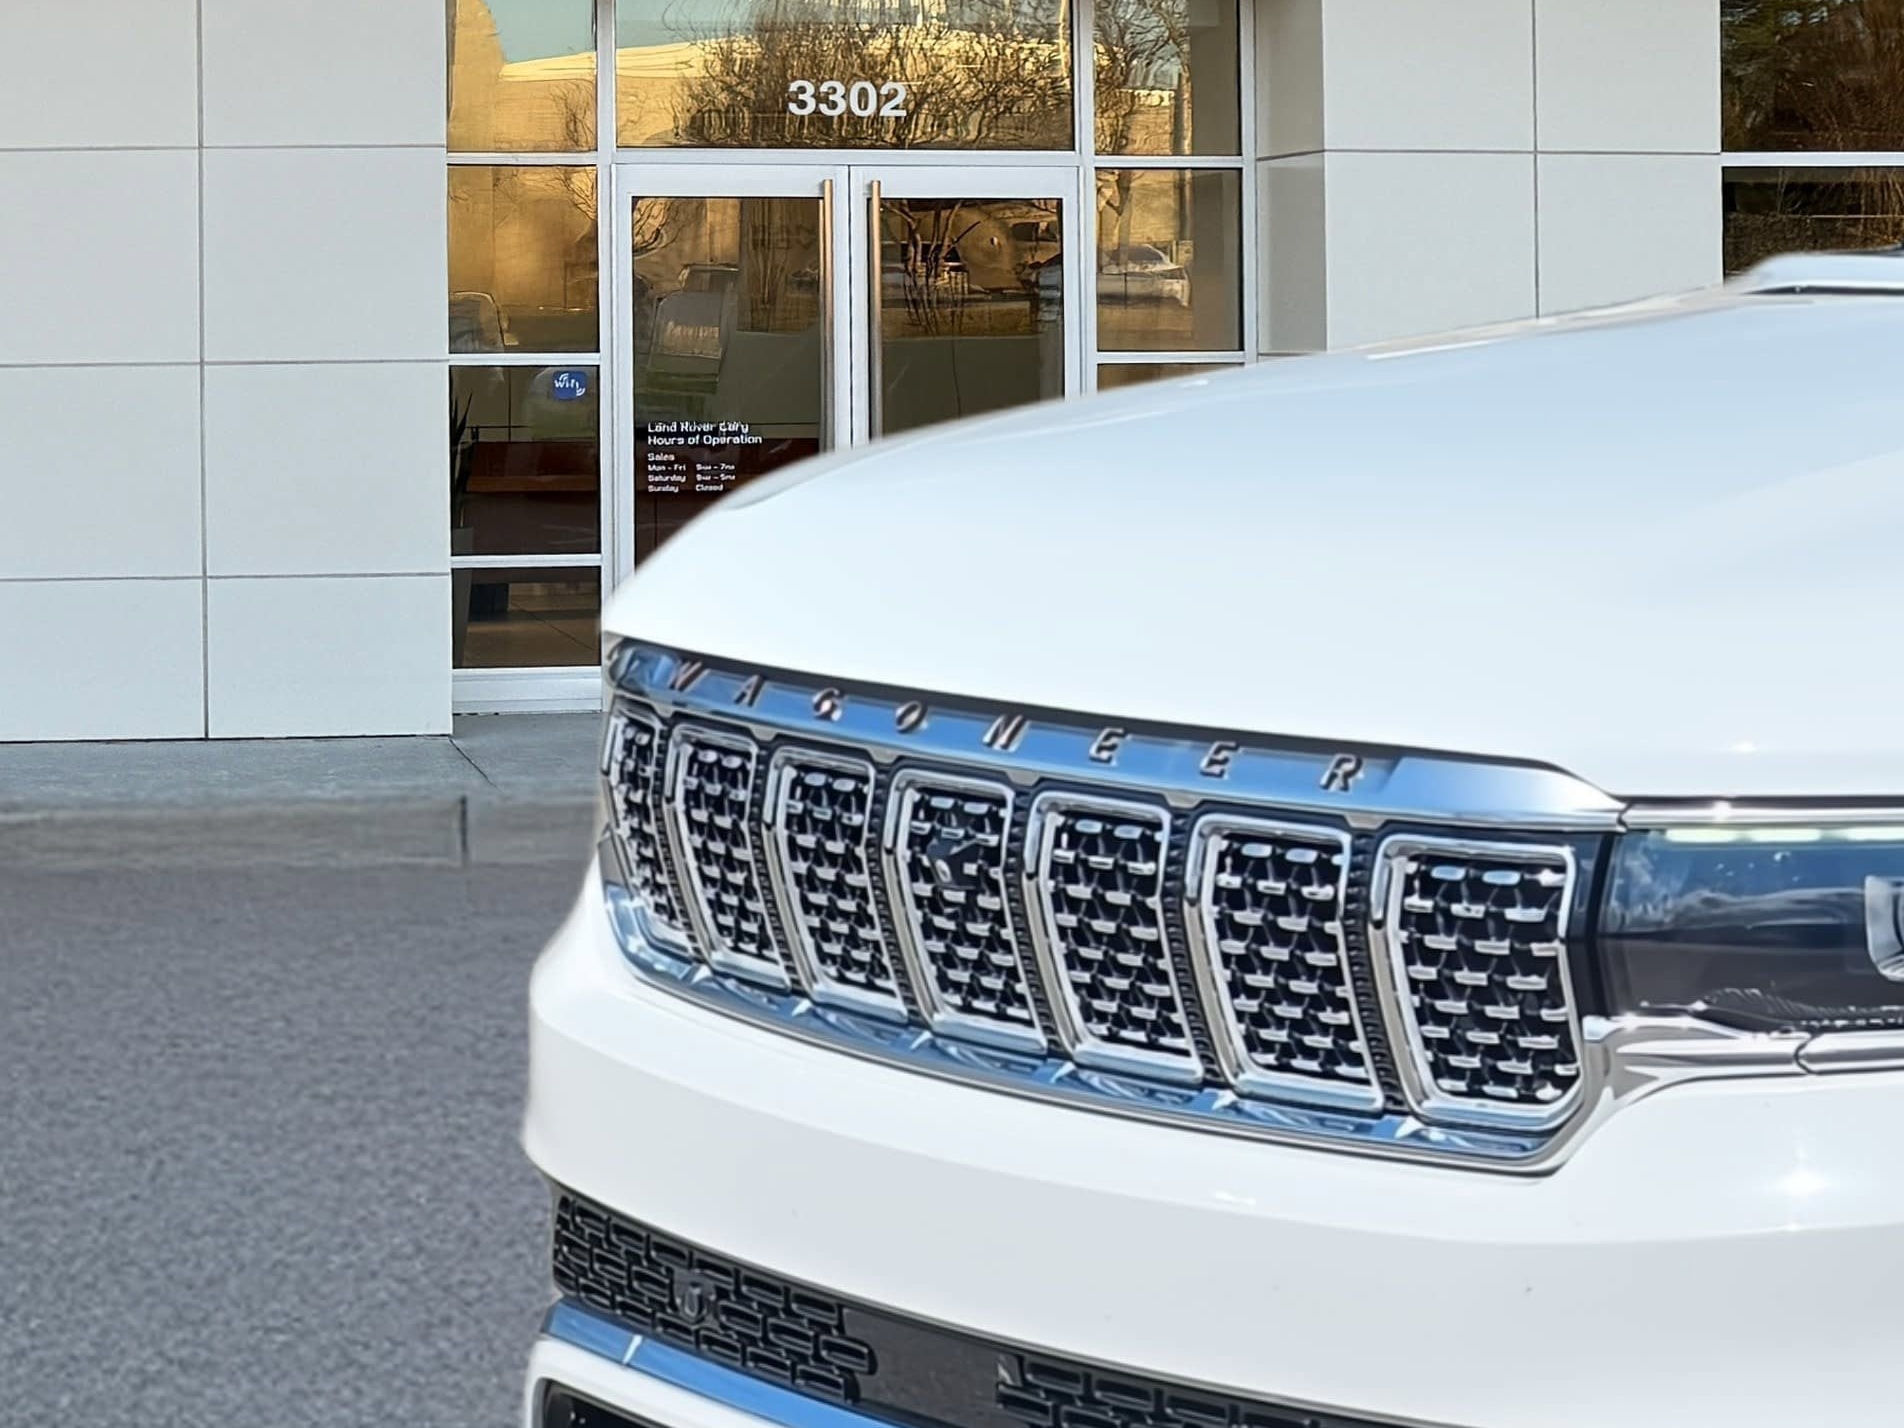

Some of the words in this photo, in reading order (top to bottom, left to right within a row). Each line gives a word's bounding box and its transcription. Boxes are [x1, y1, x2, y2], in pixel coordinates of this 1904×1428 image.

[786, 79, 909, 119] 3302
[647, 435, 685, 445] Hours
[687, 434, 699, 445] of
[703, 434, 762, 447] Operation
[667, 659, 1365, 793] WAGONEER
